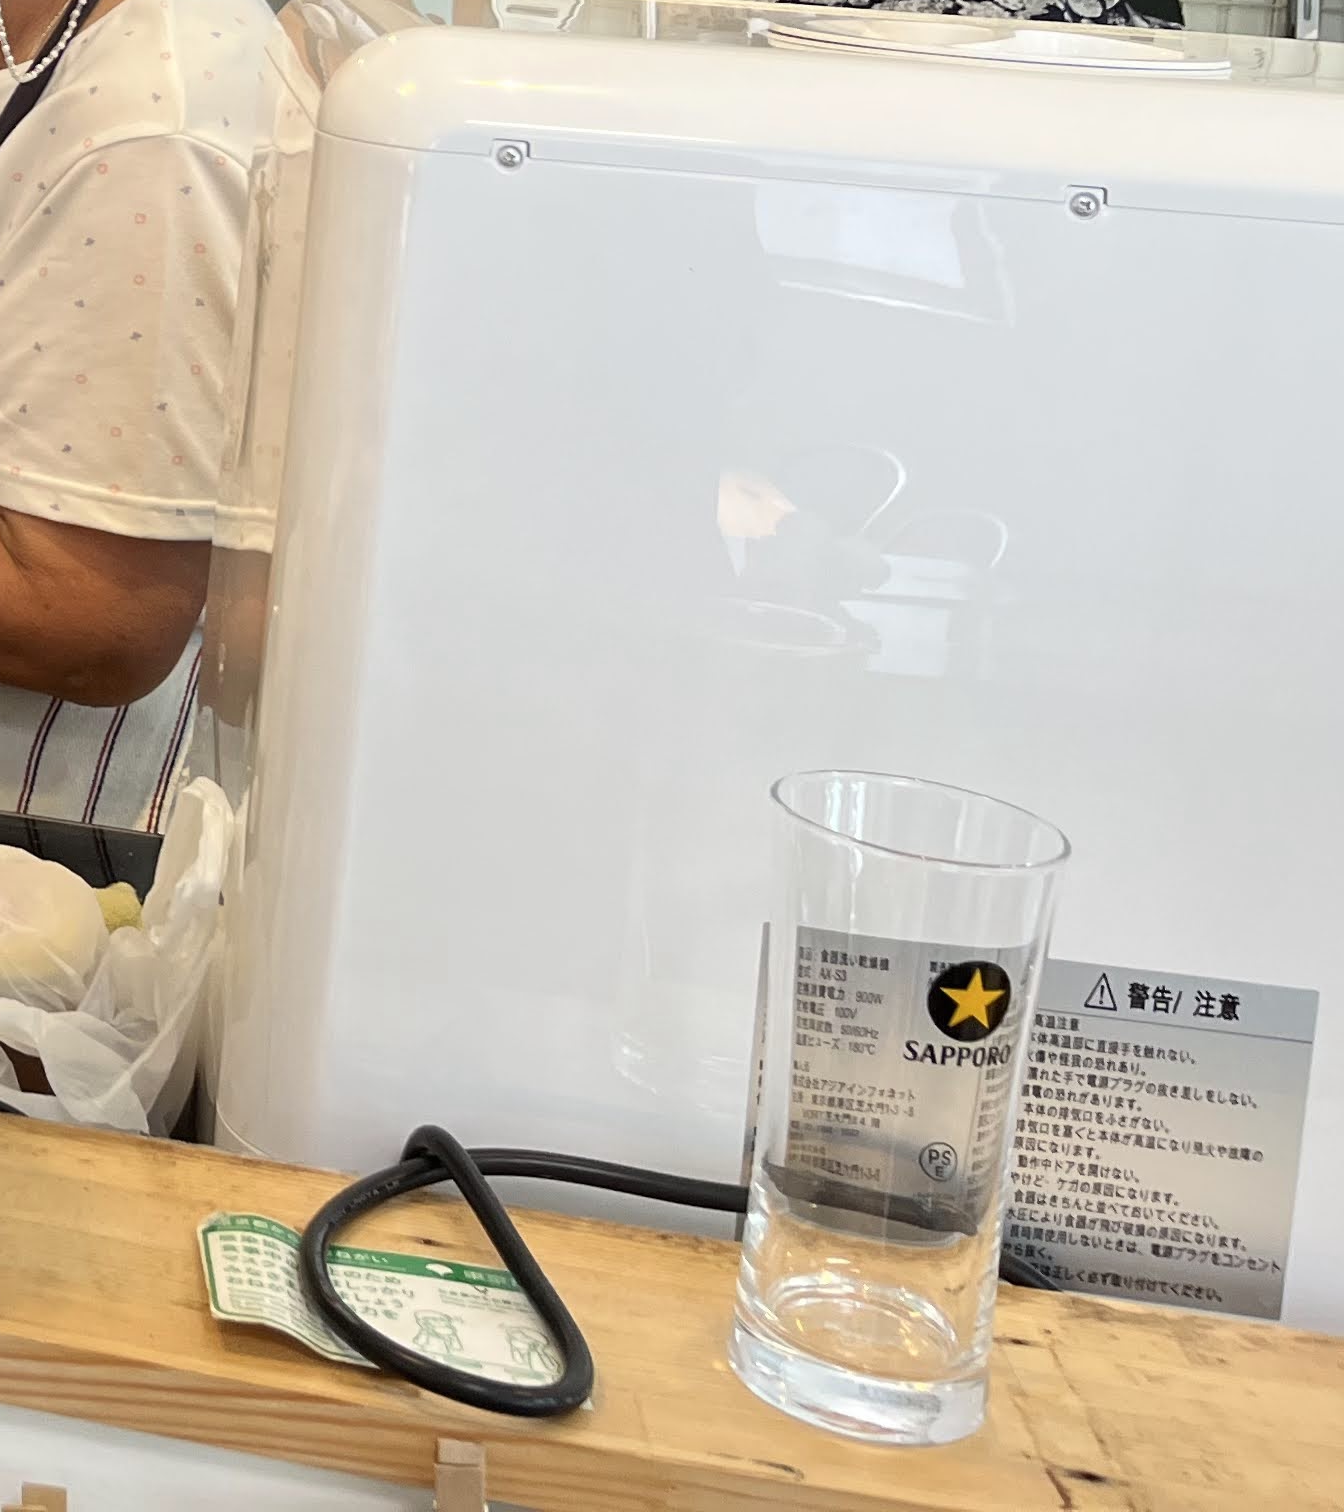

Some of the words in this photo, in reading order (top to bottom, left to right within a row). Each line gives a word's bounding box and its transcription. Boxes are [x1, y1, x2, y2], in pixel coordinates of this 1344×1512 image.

[1128, 982, 1183, 1014] 警告/
[1192, 989, 1241, 1022] 注意
[903, 1040, 1011, 1068] SAPPORO
